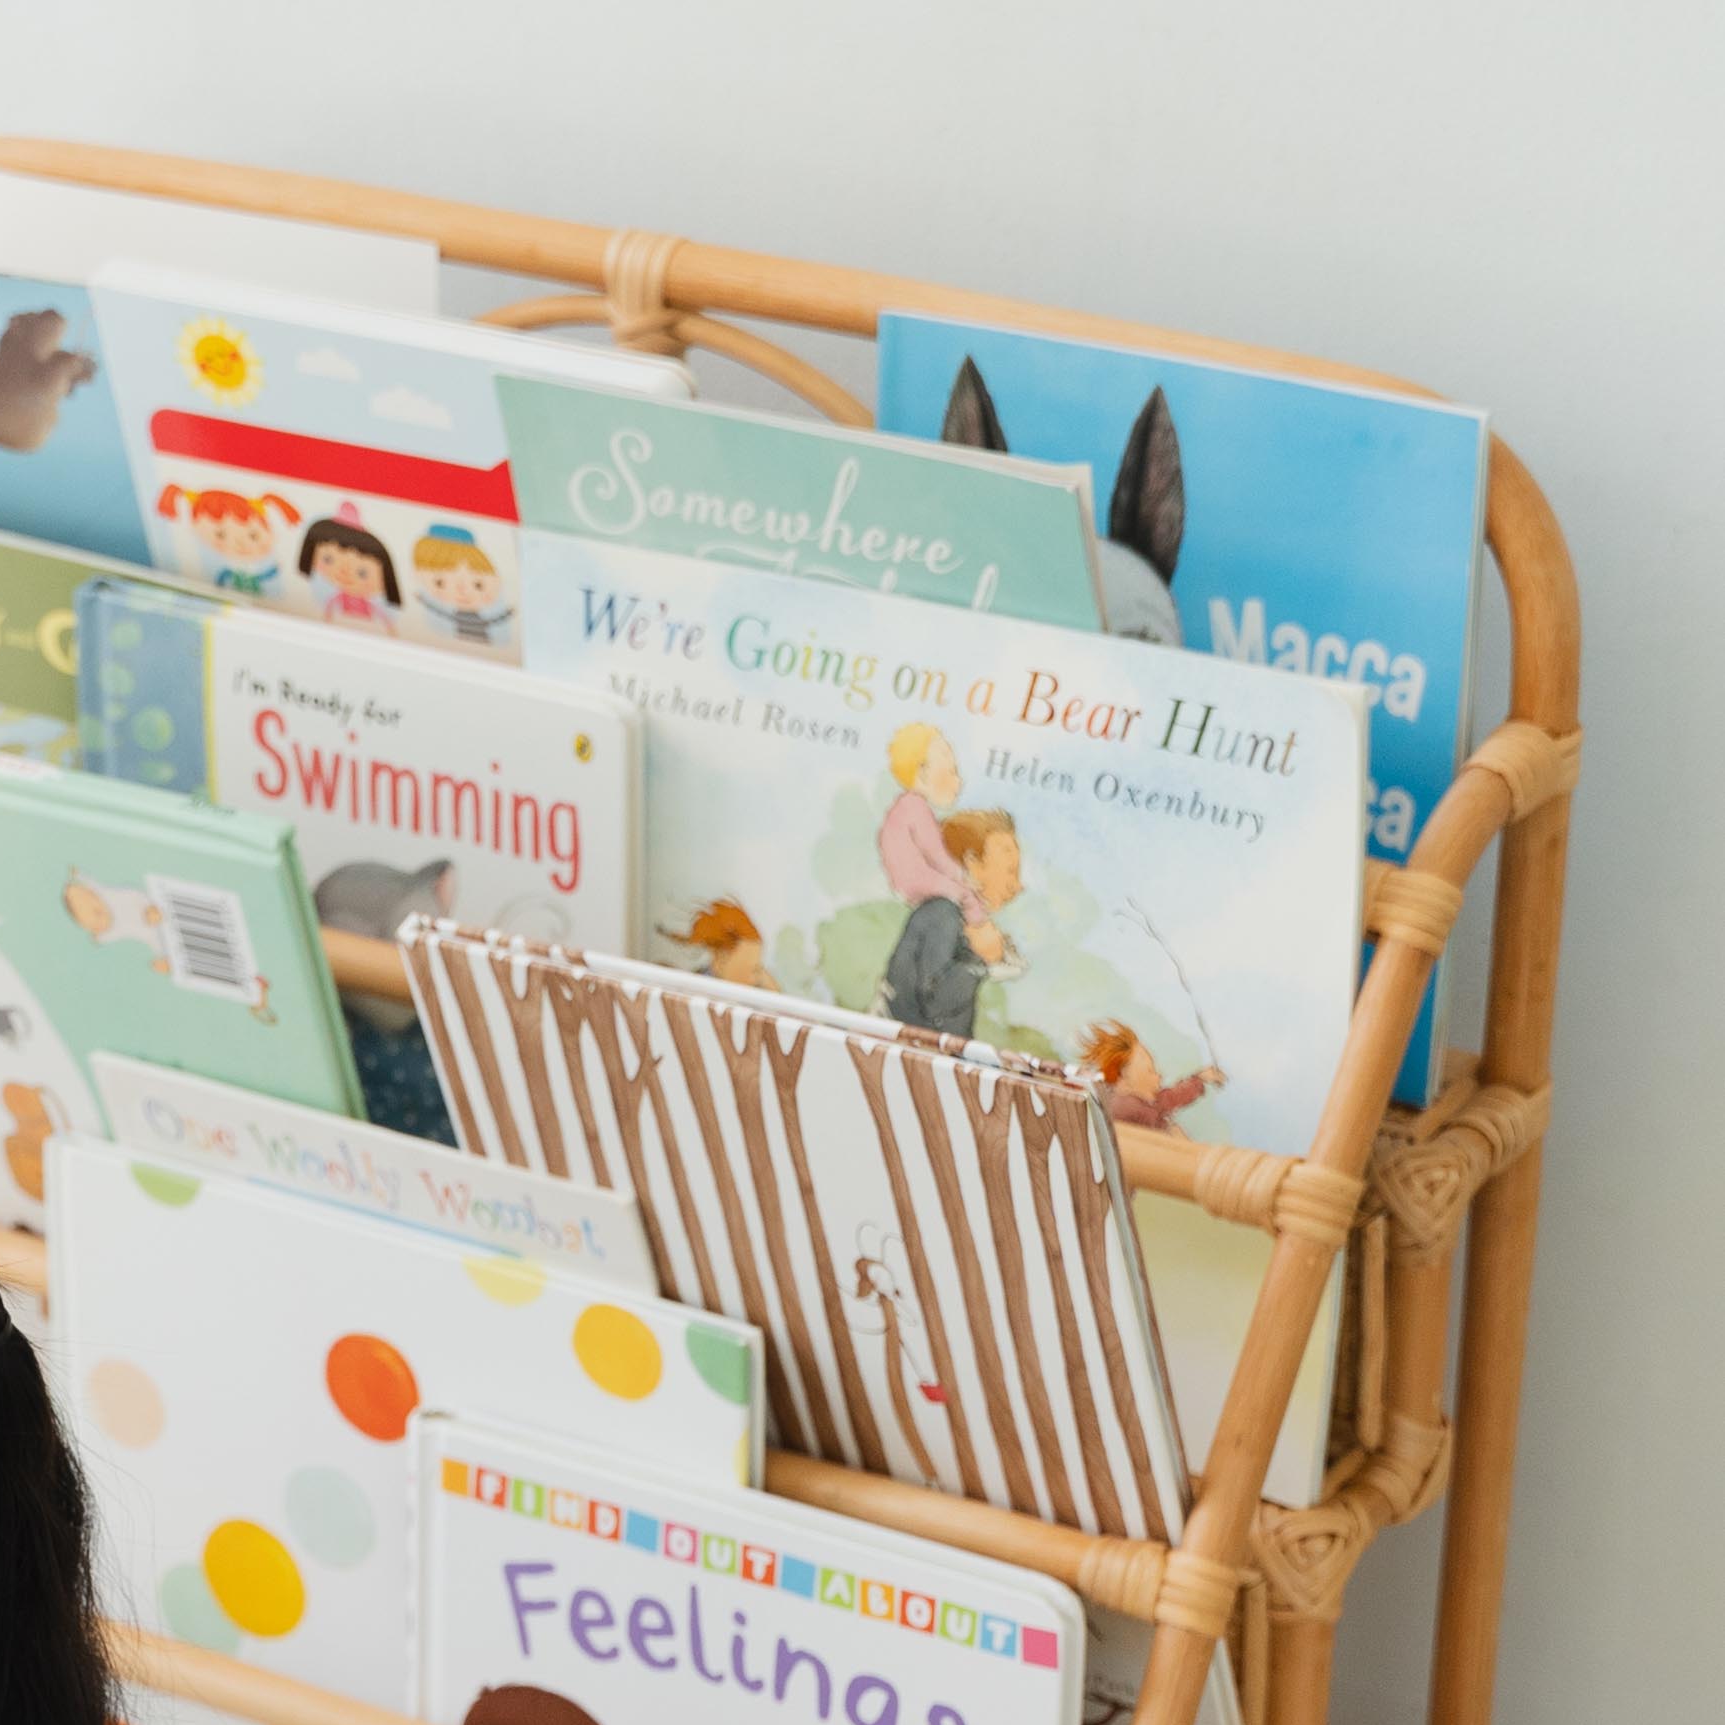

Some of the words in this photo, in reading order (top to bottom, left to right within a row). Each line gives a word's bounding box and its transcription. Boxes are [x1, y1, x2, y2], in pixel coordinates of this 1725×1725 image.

[568, 429, 963, 573] Somewhere
[579, 587, 705, 660] We're
[725, 615, 880, 712] Going
[892, 662, 948, 708] on
[966, 676, 997, 716] a
[1017, 668, 1143, 742] Bear
[1159, 698, 1301, 777] Hunt
[609, 672, 743, 726] Michael
[760, 702, 863, 749] Rosen
[1208, 597, 1428, 723] Macca
[253, 708, 585, 894] Swimming
[984, 747, 1076, 796] Helen
[1092, 770, 1266, 842] Oxenbury
[141, 1097, 238, 1161] One
[418, 1167, 607, 1259] Wombat
[480, 1468, 620, 1540] FIND
[664, 1523, 774, 1585] OUT
[823, 1570, 1014, 1655] ABOUT
